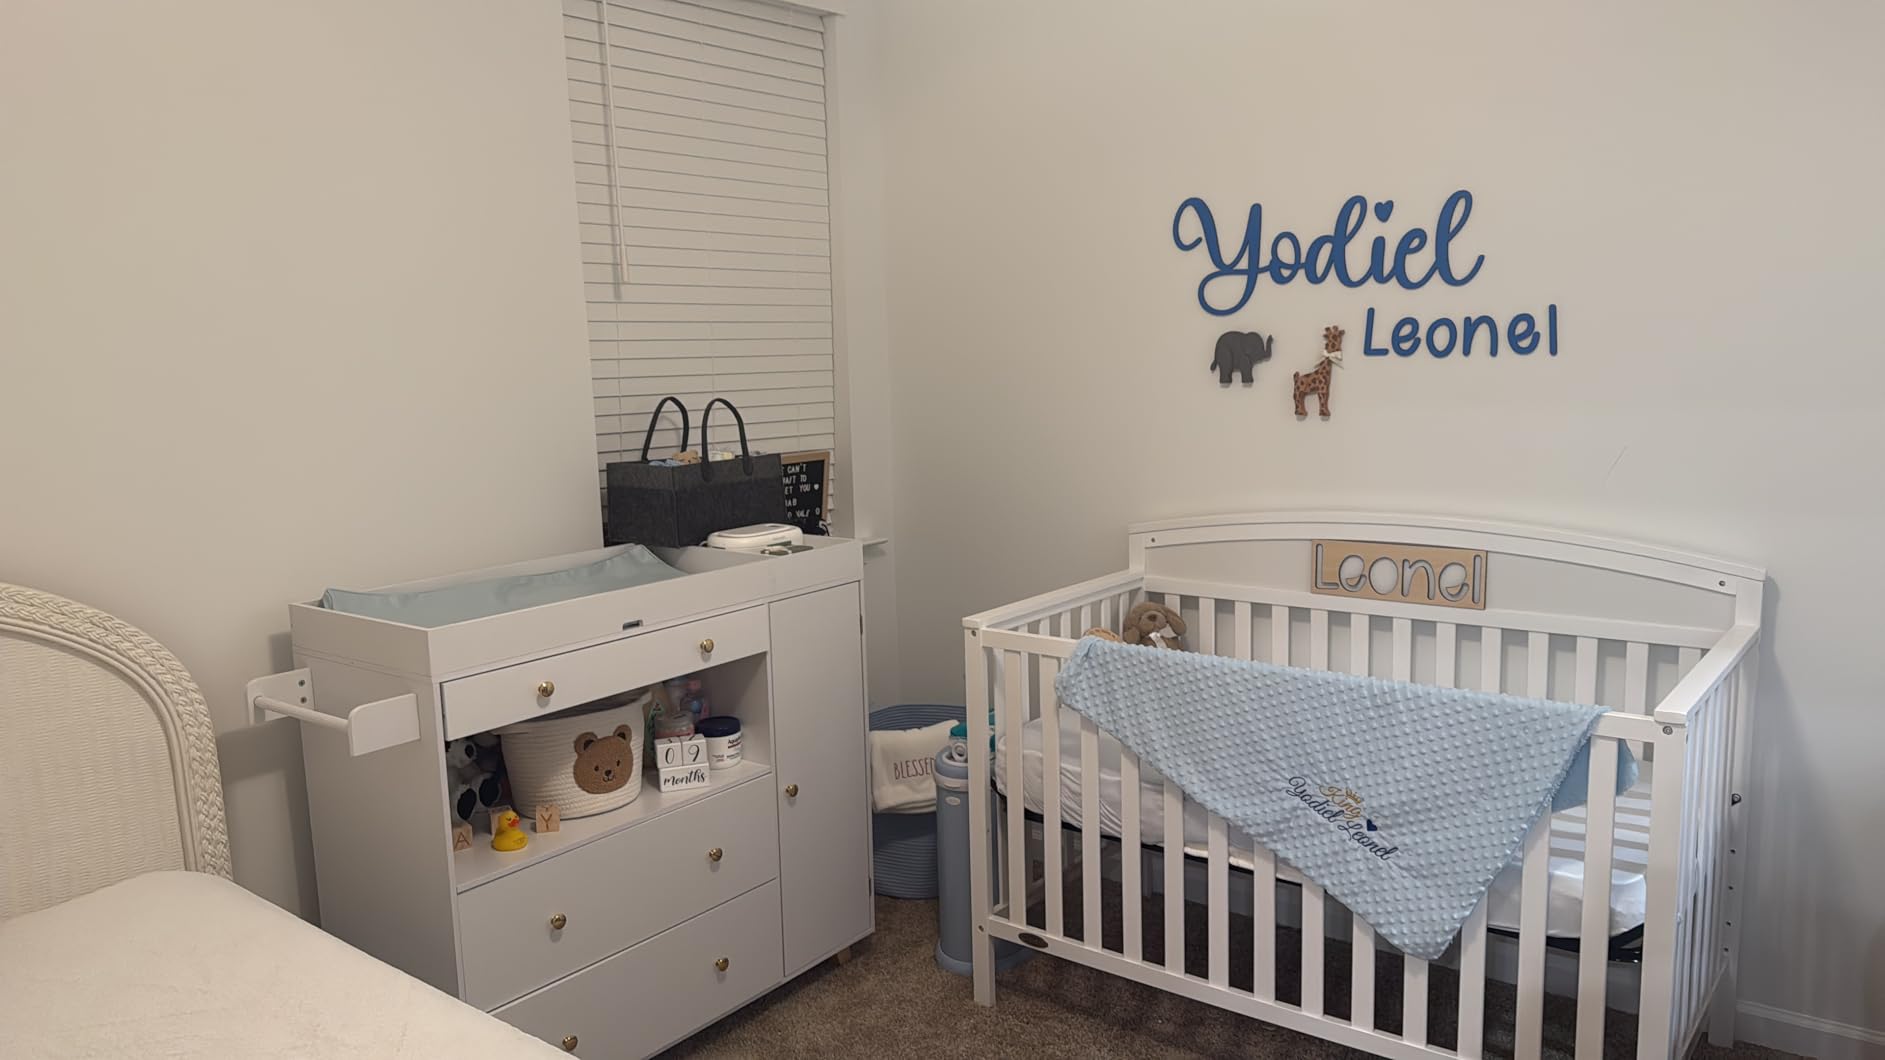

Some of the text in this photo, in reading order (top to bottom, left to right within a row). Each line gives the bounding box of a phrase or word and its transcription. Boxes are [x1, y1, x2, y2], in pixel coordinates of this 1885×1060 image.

[1173, 190, 1485, 316] Yodiel
[1364, 304, 1558, 358] Leonel
[787, 463, 807, 474] CAN'T
[800, 475, 807, 483] TO
[799, 484, 811, 494] YOU
[1315, 543, 1482, 604] Leonel
[663, 769, 706, 786] months
[1319, 786, 1362, 820] King
[540, 814, 553, 831] Y
[1286, 776, 1399, 861] Yodiel Leonel
[454, 832, 470, 850] A
